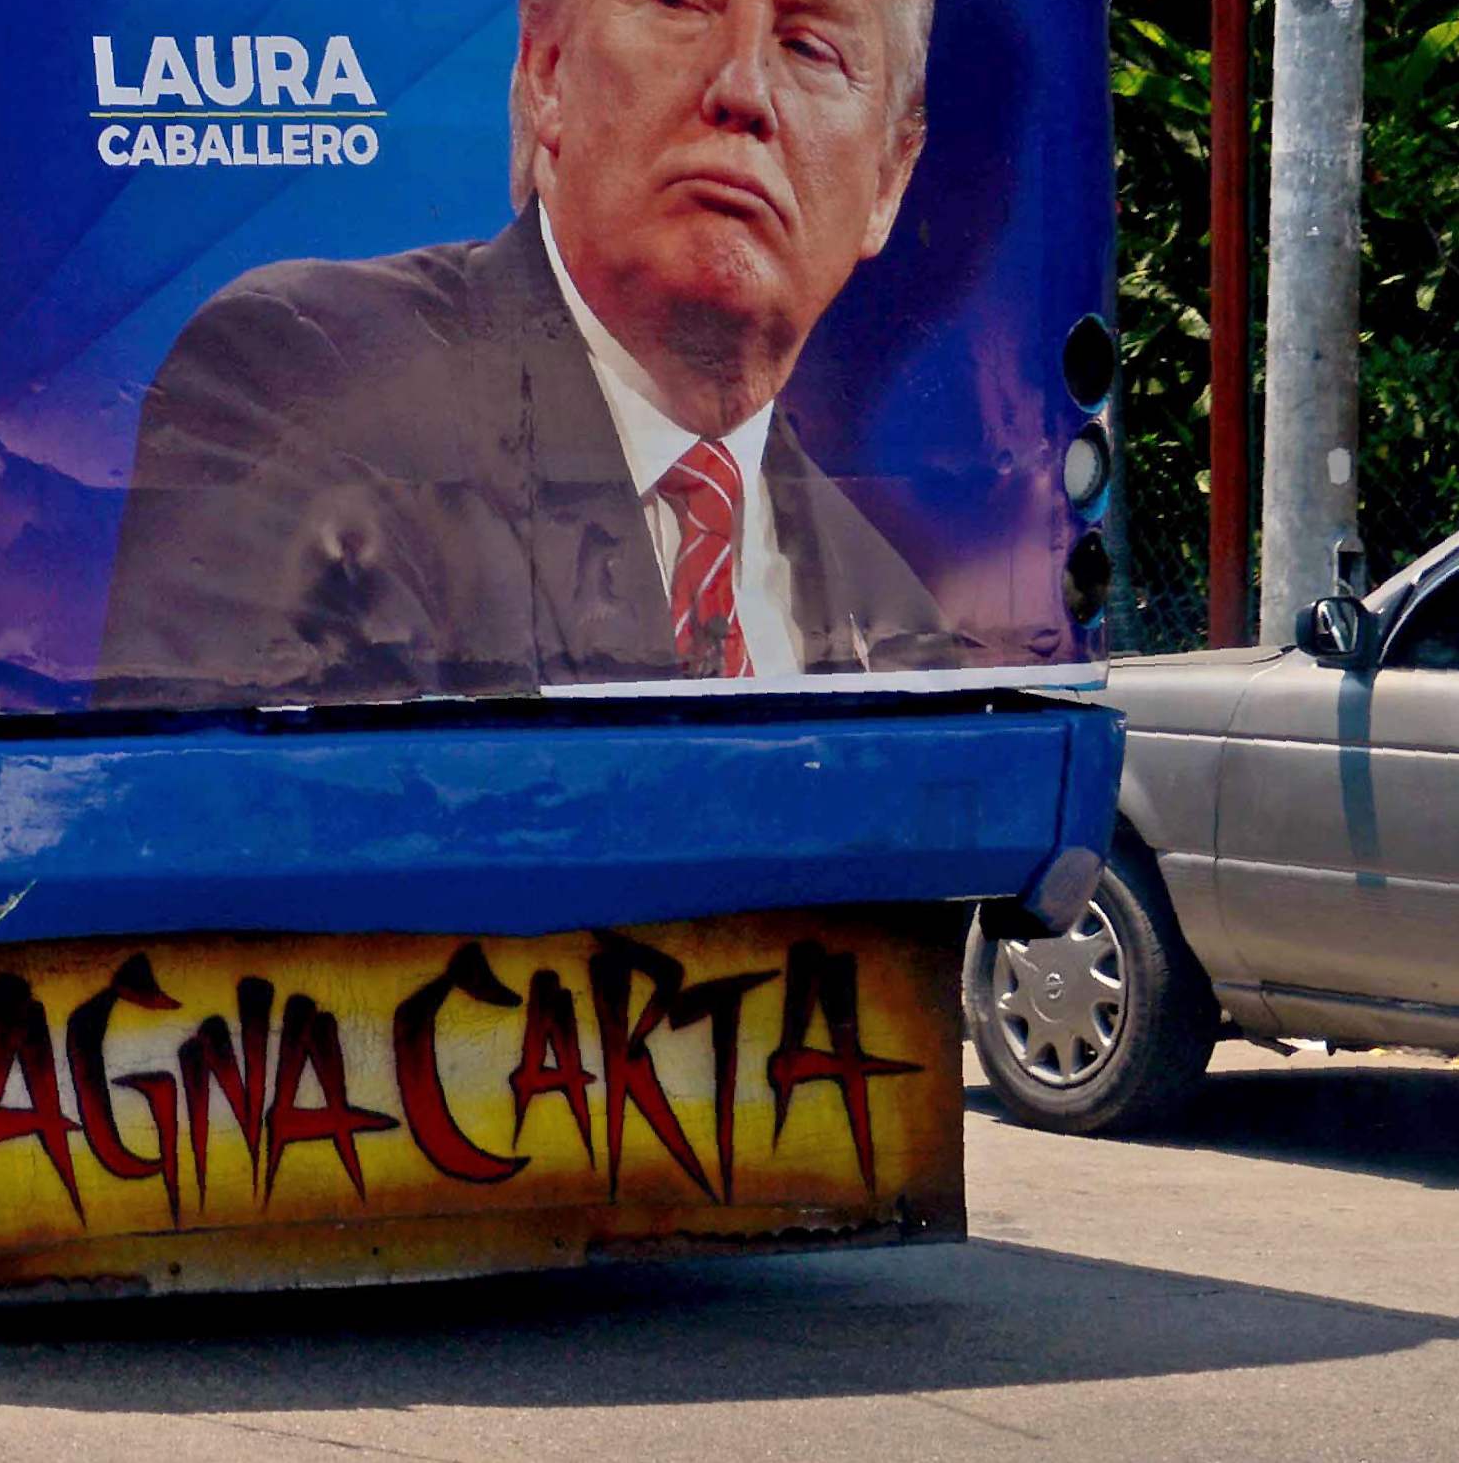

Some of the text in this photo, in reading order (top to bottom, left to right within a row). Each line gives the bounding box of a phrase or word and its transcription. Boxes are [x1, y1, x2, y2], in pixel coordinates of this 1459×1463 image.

[92, 35, 378, 106] LAURA
[97, 123, 380, 166] CABALLERO
[394, 937, 925, 1205] CARTA
